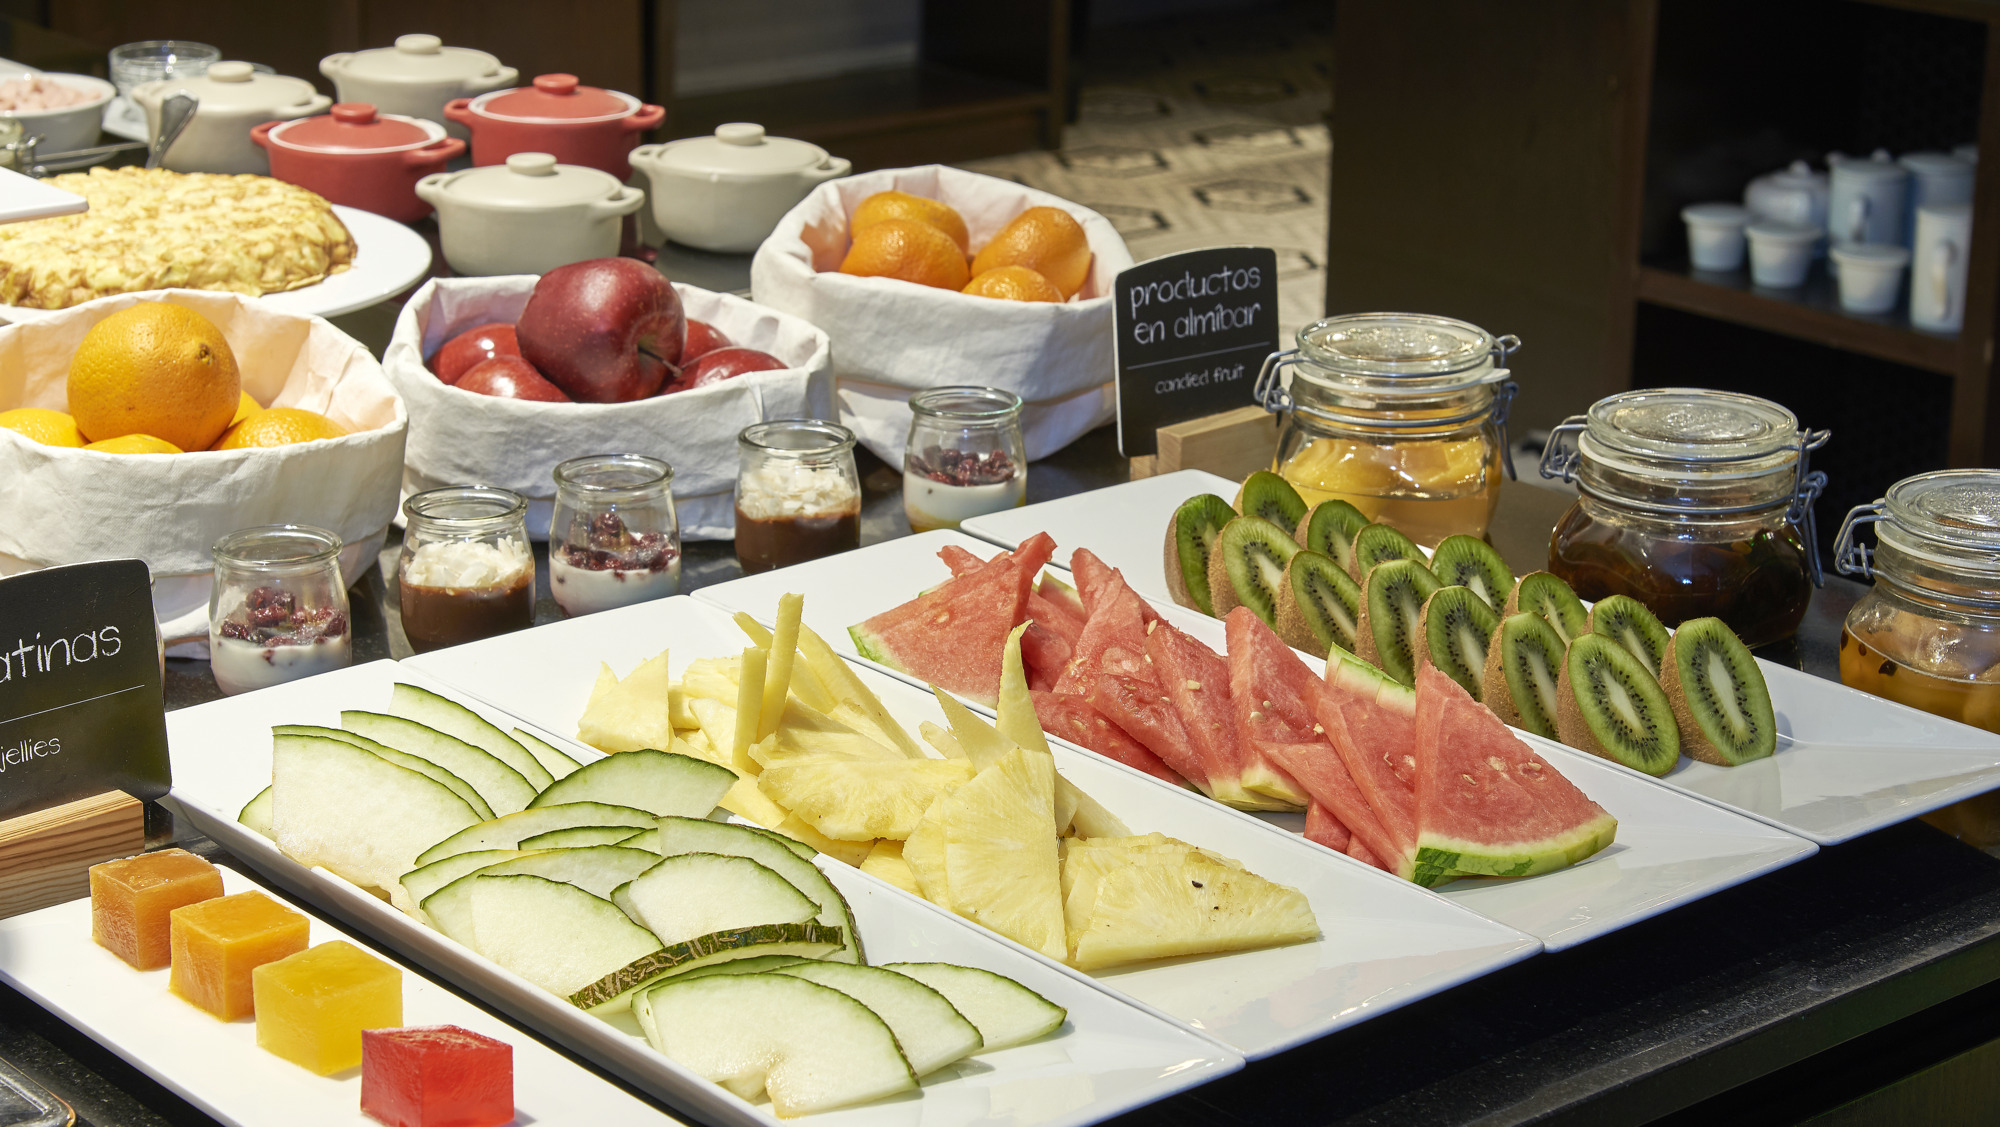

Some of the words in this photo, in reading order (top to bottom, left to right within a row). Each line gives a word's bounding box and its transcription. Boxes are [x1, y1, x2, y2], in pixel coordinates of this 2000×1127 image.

[1130, 266, 1261, 320] productos
[1134, 320, 1165, 344] en
[1174, 302, 1261, 338] almíbar
[1154, 369, 1209, 394] candied
[1213, 363, 1245, 383] fruit
[0, 738, 61, 773] jellies
